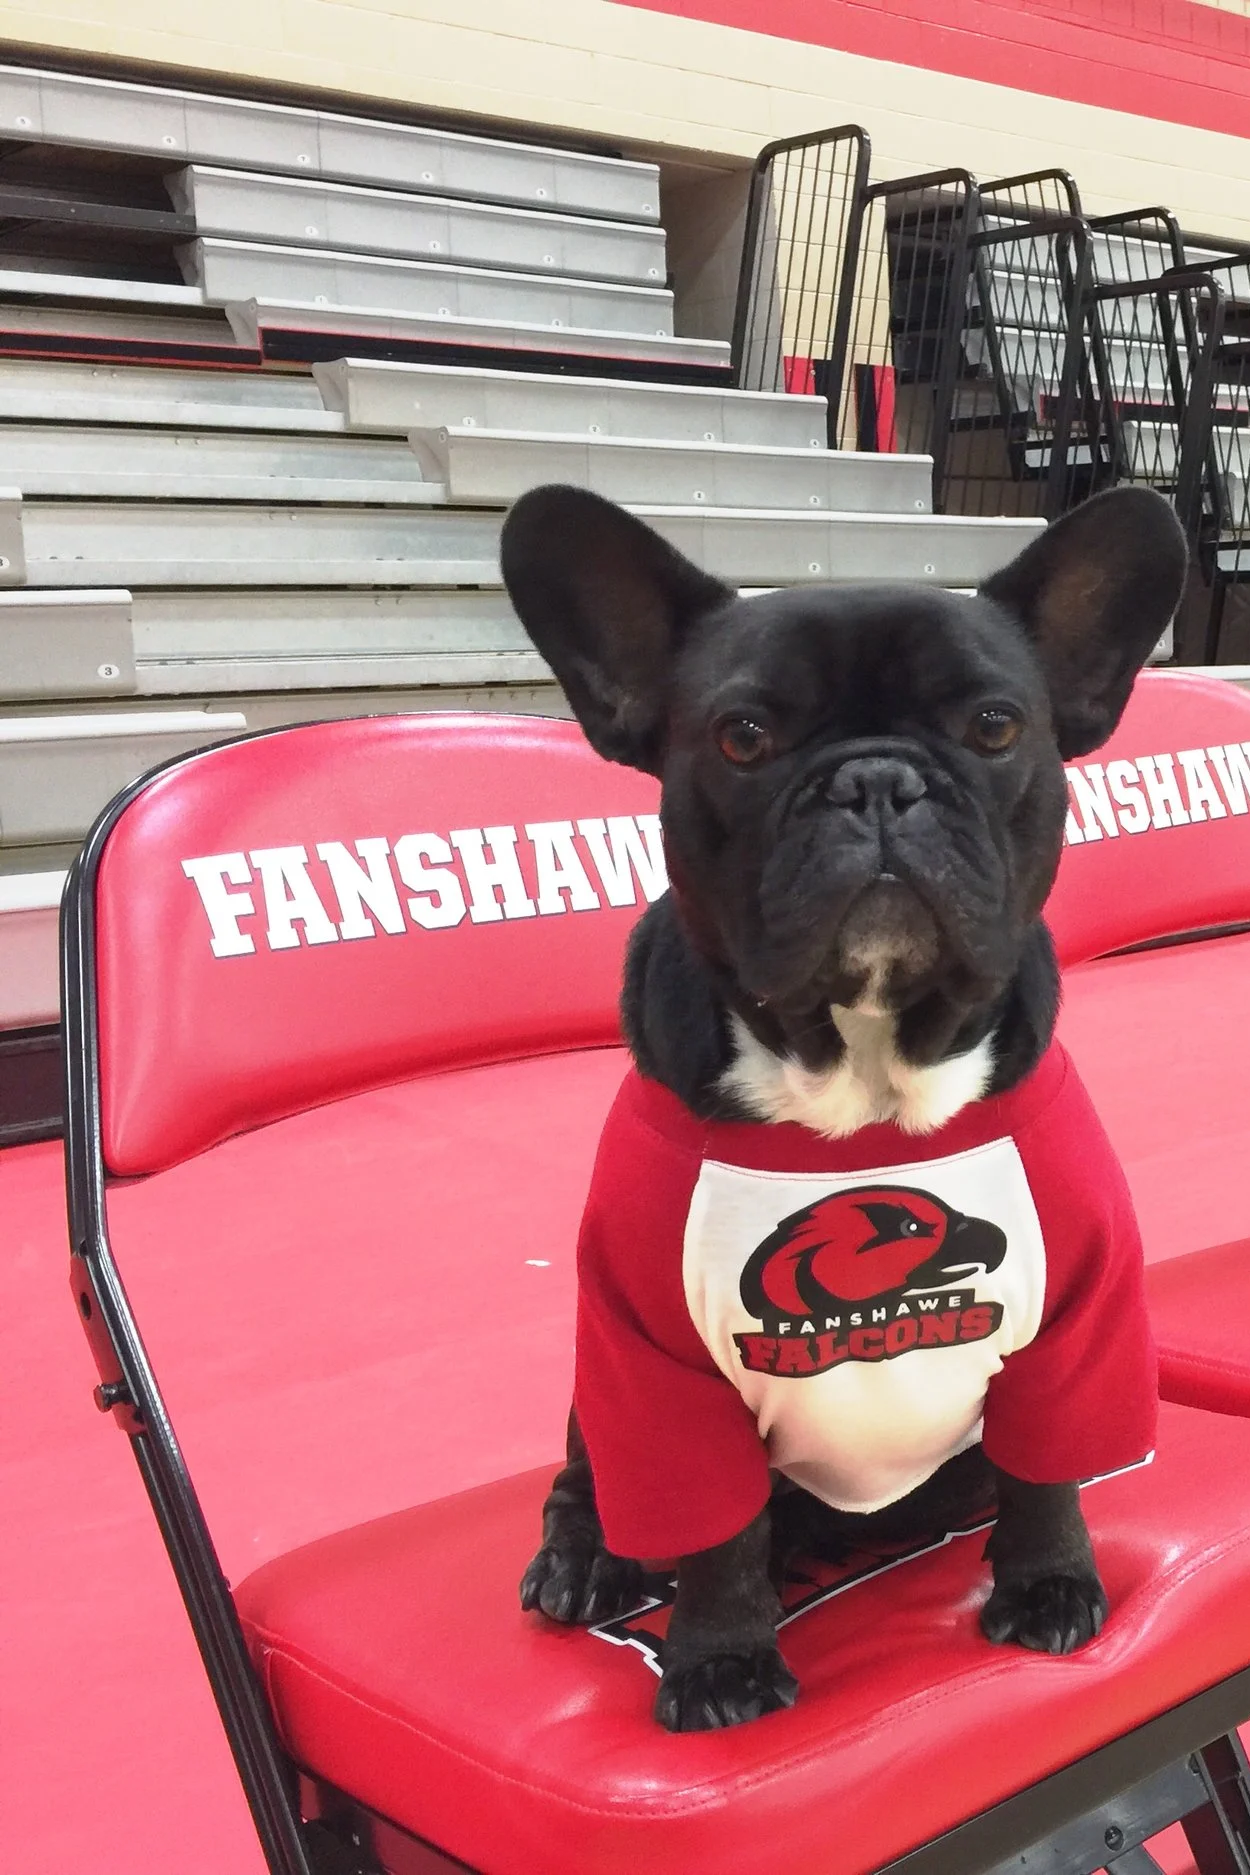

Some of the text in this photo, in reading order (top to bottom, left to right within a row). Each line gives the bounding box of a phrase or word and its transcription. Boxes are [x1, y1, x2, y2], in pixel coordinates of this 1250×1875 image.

[104, 666, 113, 676] 3
[180, 812, 670, 958] FANSHAW
[740, 1305, 995, 1374] FALCONS
[778, 1295, 962, 1335] FANSHAWE
